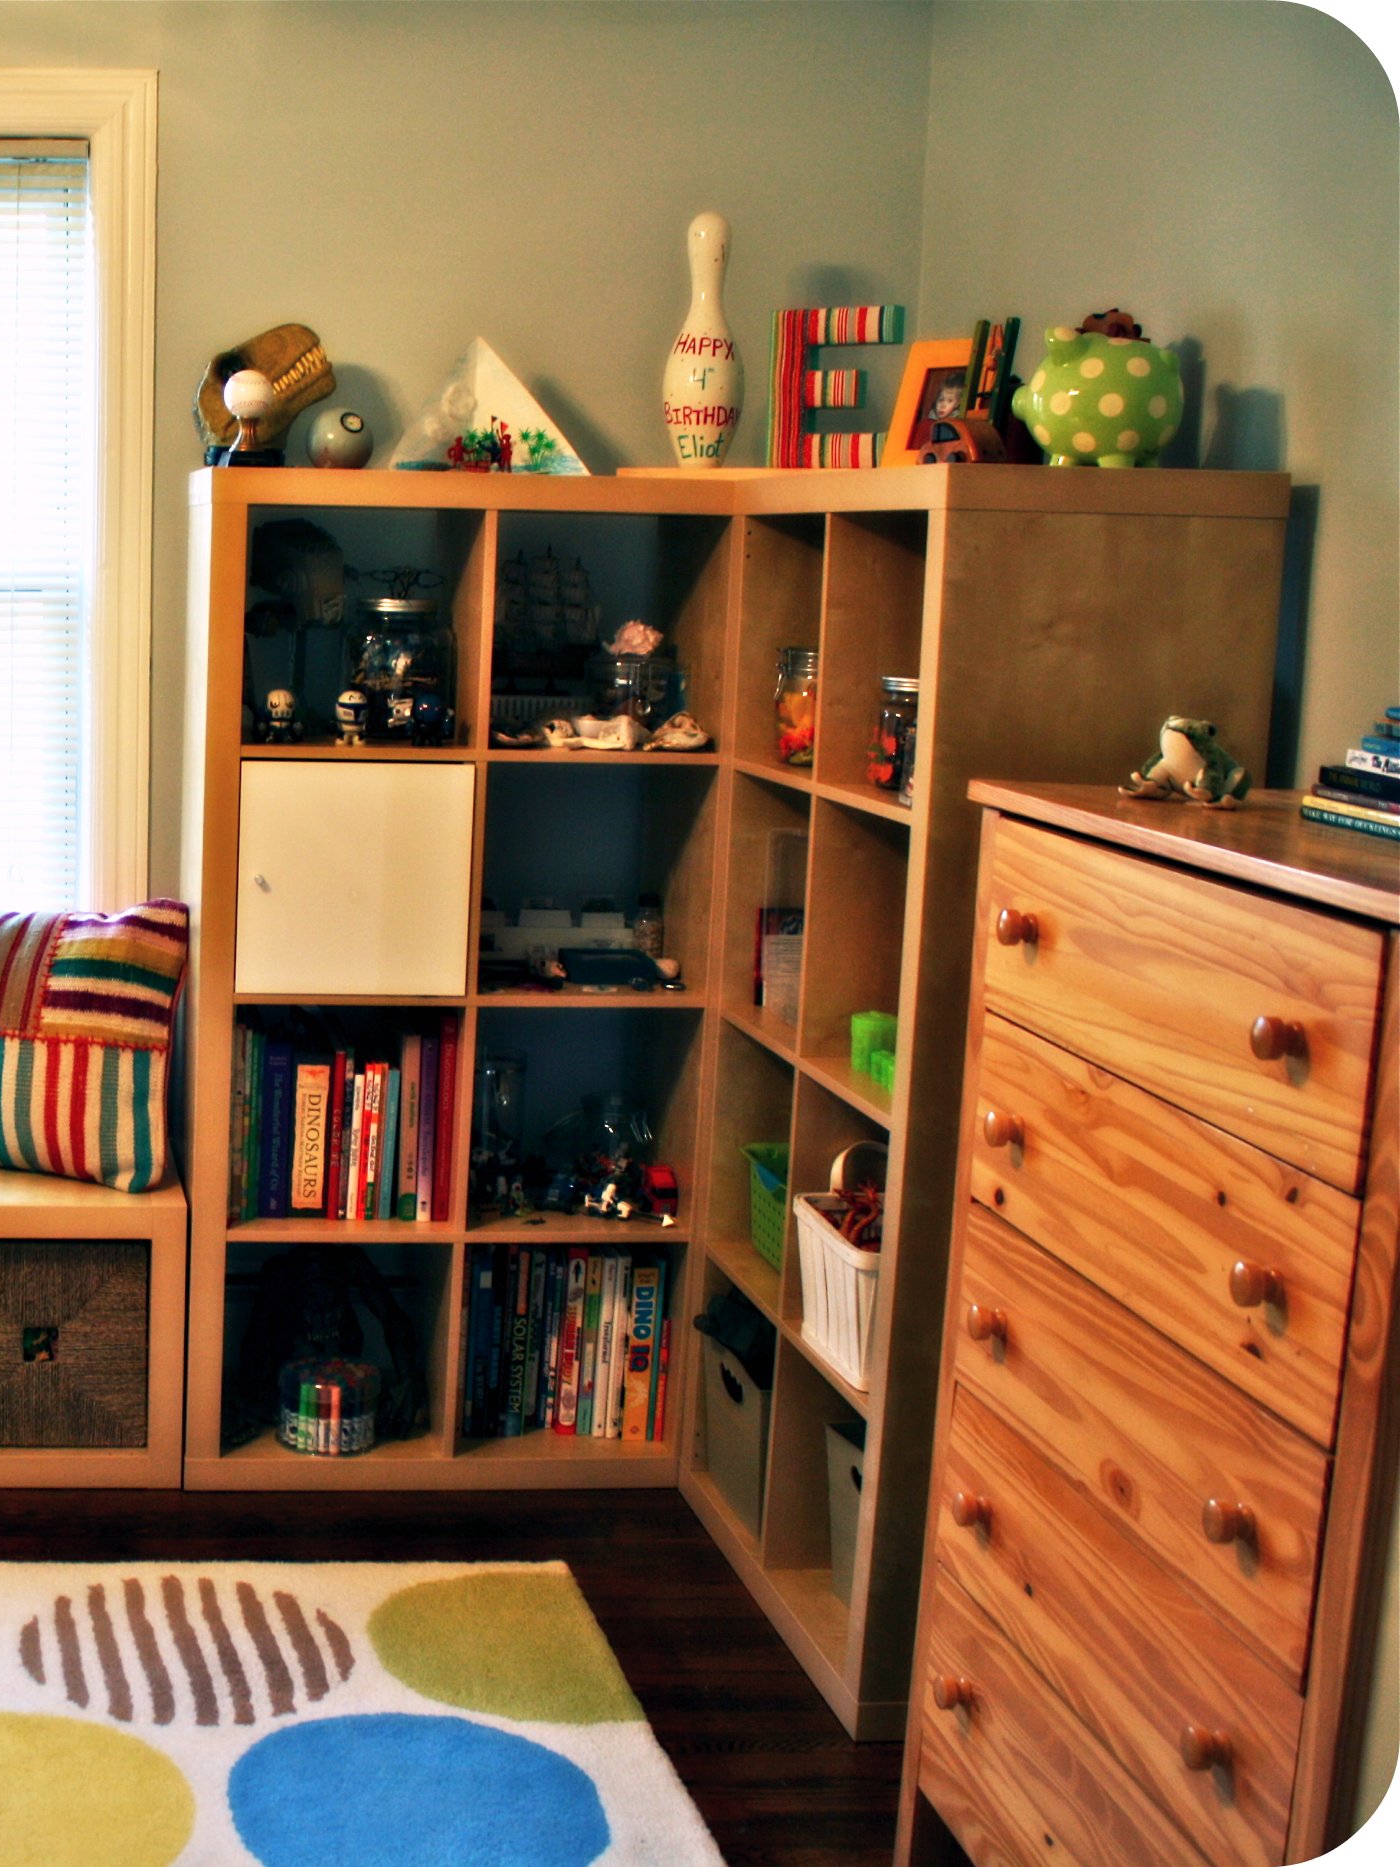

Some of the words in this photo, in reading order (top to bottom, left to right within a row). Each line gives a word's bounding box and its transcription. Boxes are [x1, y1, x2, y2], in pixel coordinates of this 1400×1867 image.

[674, 333, 735, 361] HAPPY
[678, 432, 724, 459] Eliot
[303, 1093, 322, 1198] DINOSAURS
[633, 1286, 654, 1340] DINO
[512, 1317, 527, 1362] SOLAR
[630, 1345, 651, 1373] IQ
[508, 1365, 522, 1413] SYSTEM
